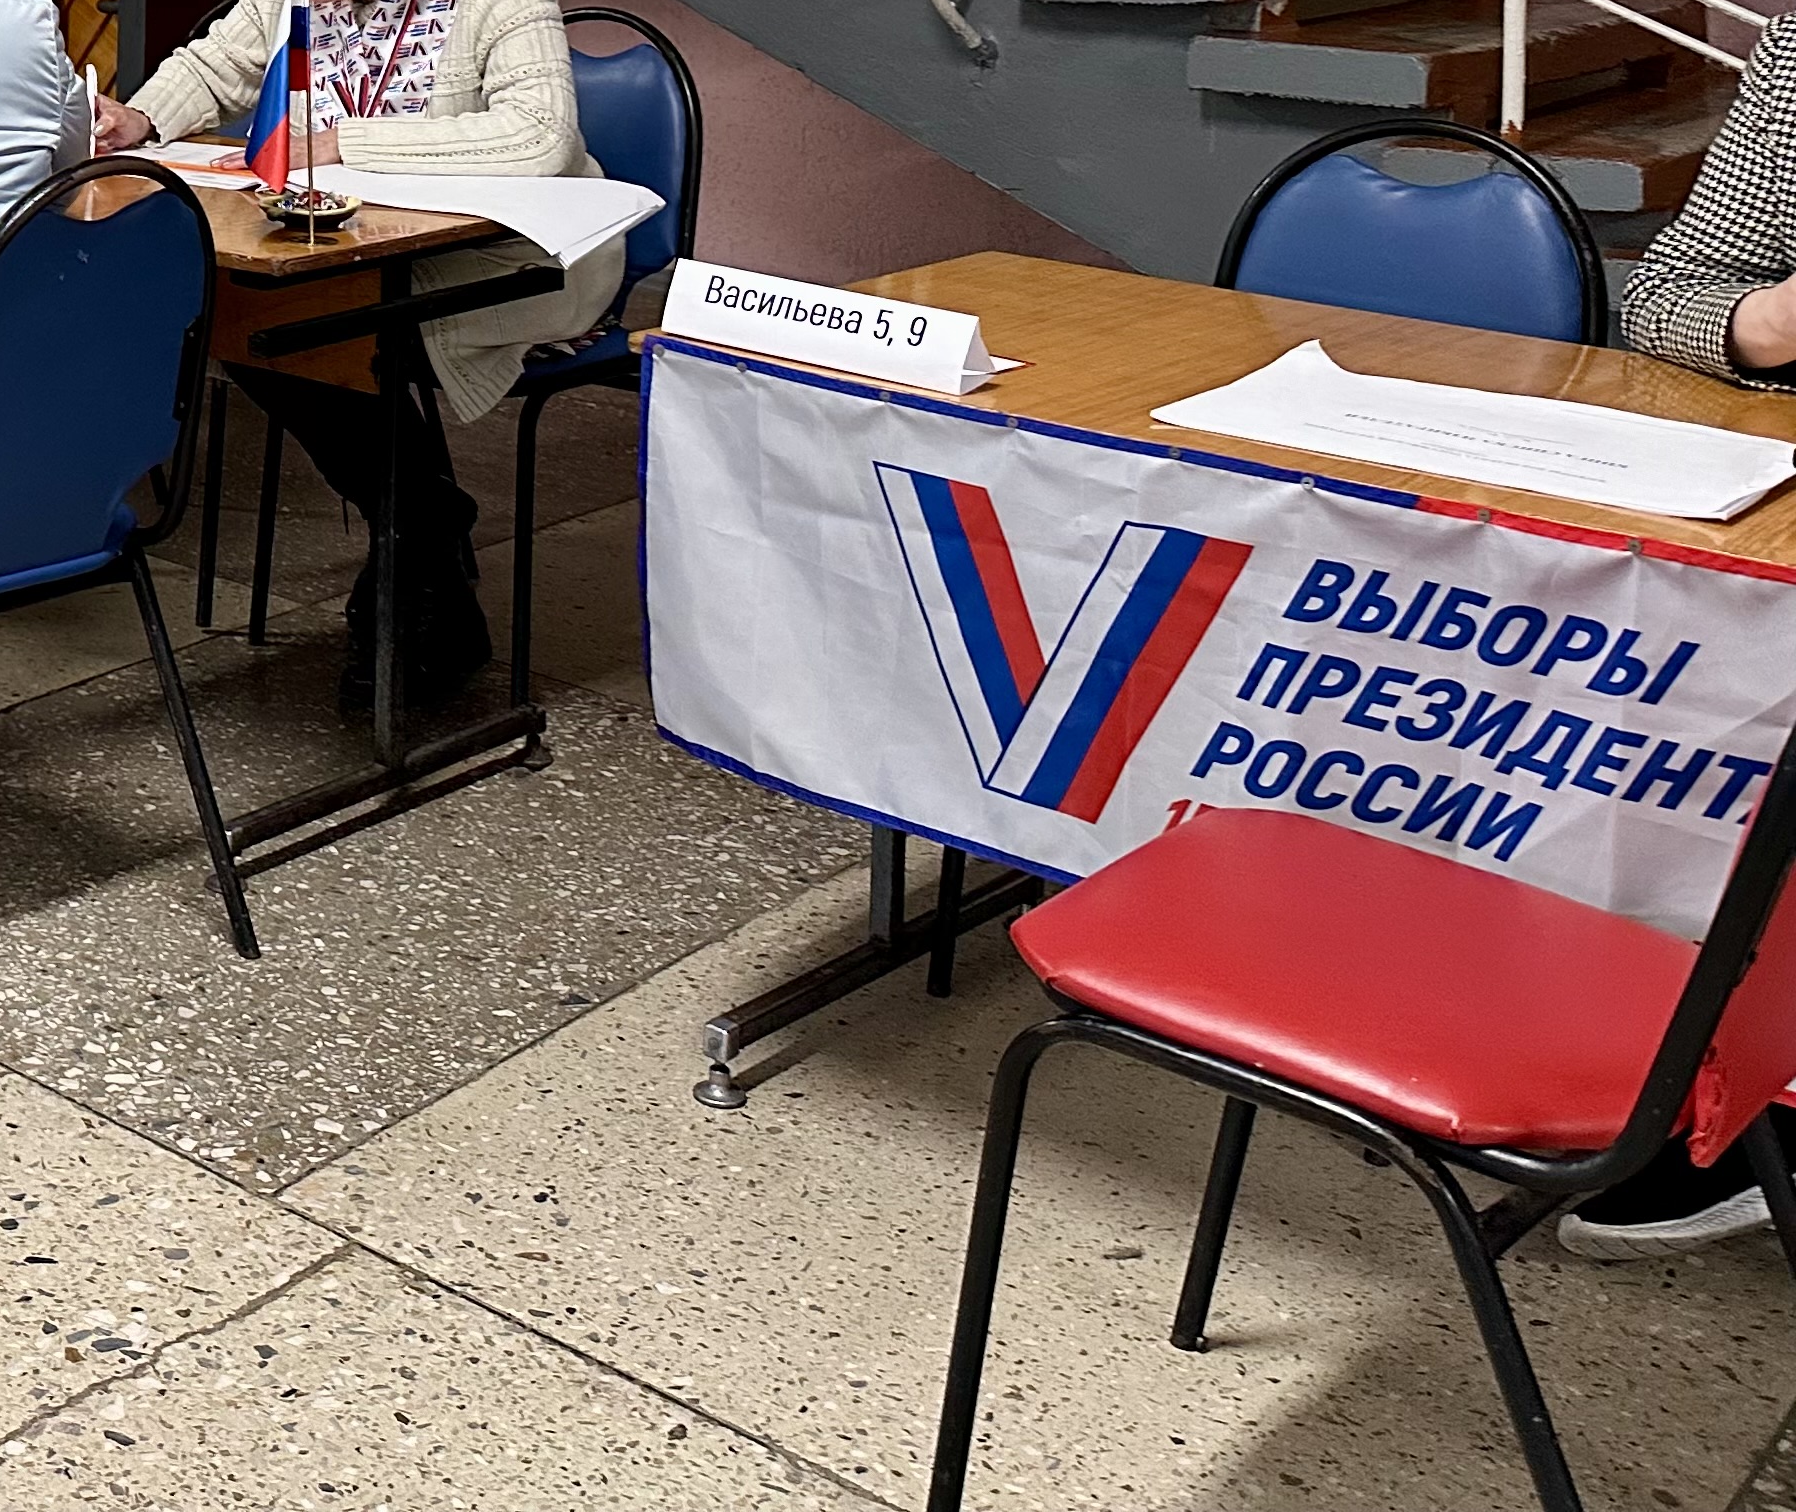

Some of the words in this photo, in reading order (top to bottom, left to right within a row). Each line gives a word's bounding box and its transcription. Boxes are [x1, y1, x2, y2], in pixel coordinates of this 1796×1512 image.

[704, 274, 863, 334] Васильева
[872, 309, 894, 347] 5,
[906, 315, 928, 347] 9
[1282, 558, 1701, 706] ВЫБОРЫ
[1189, 721, 1545, 863] РОССИИ
[1236, 642, 1773, 825] ПРЕЗИДЕНТ
